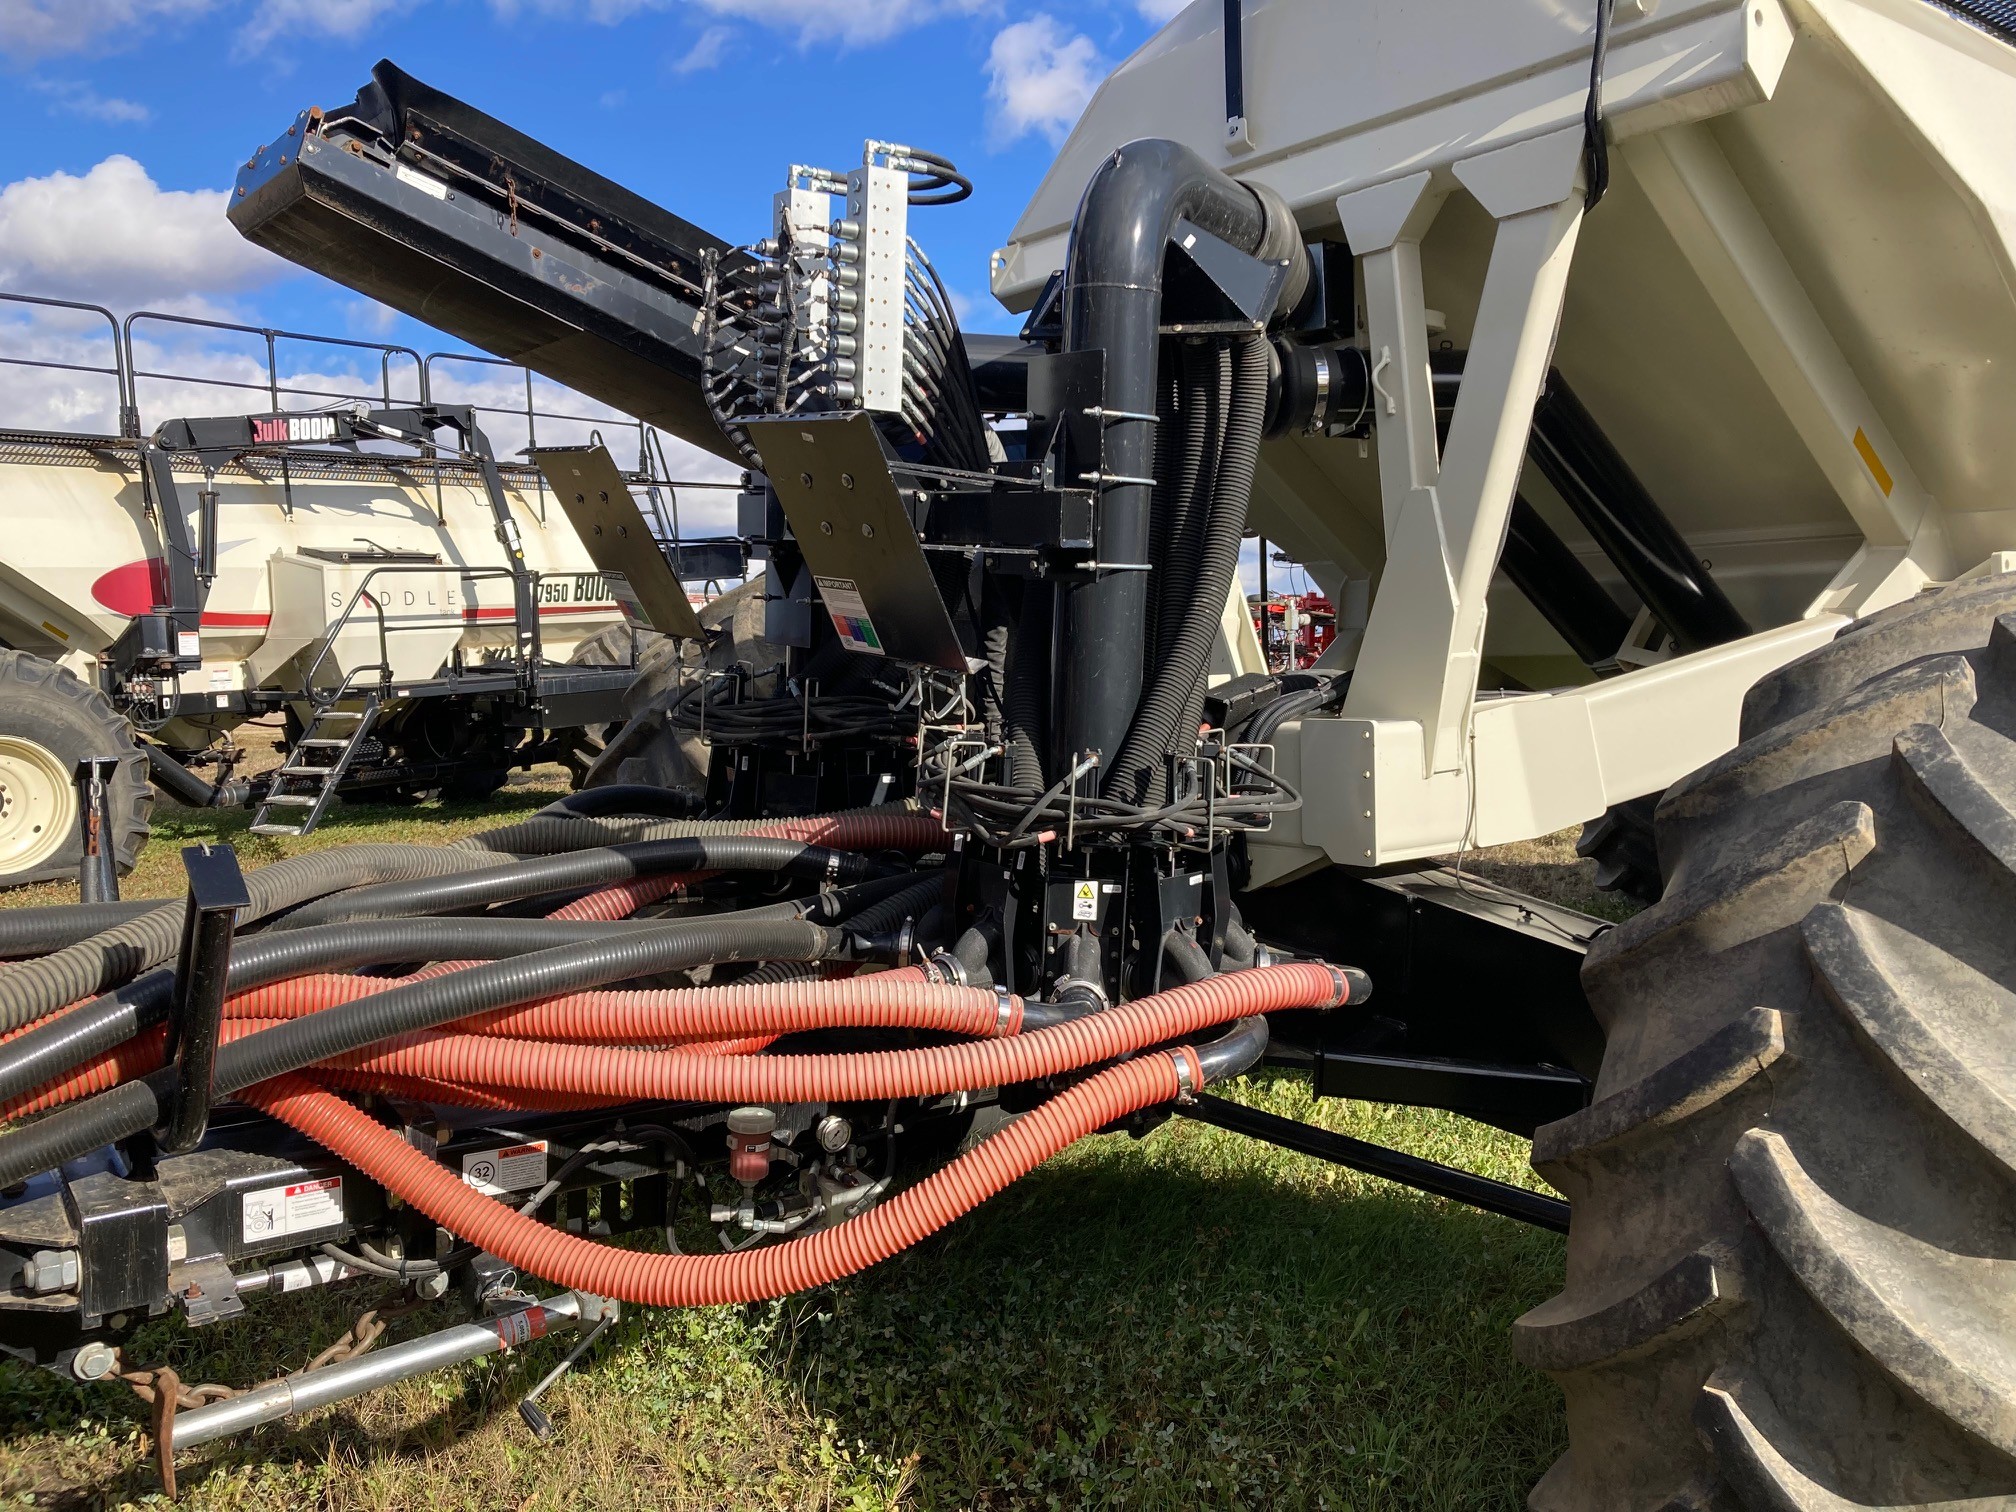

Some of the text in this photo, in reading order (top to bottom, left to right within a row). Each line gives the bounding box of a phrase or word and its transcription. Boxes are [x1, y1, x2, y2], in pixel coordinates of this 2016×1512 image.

[331, 590, 456, 608] SDDLE
[538, 583, 568, 603] 7950
[510, 1144, 542, 1156] WARNING
[474, 1166, 490, 1179] 32
[303, 1181, 333, 1193] DANGER
